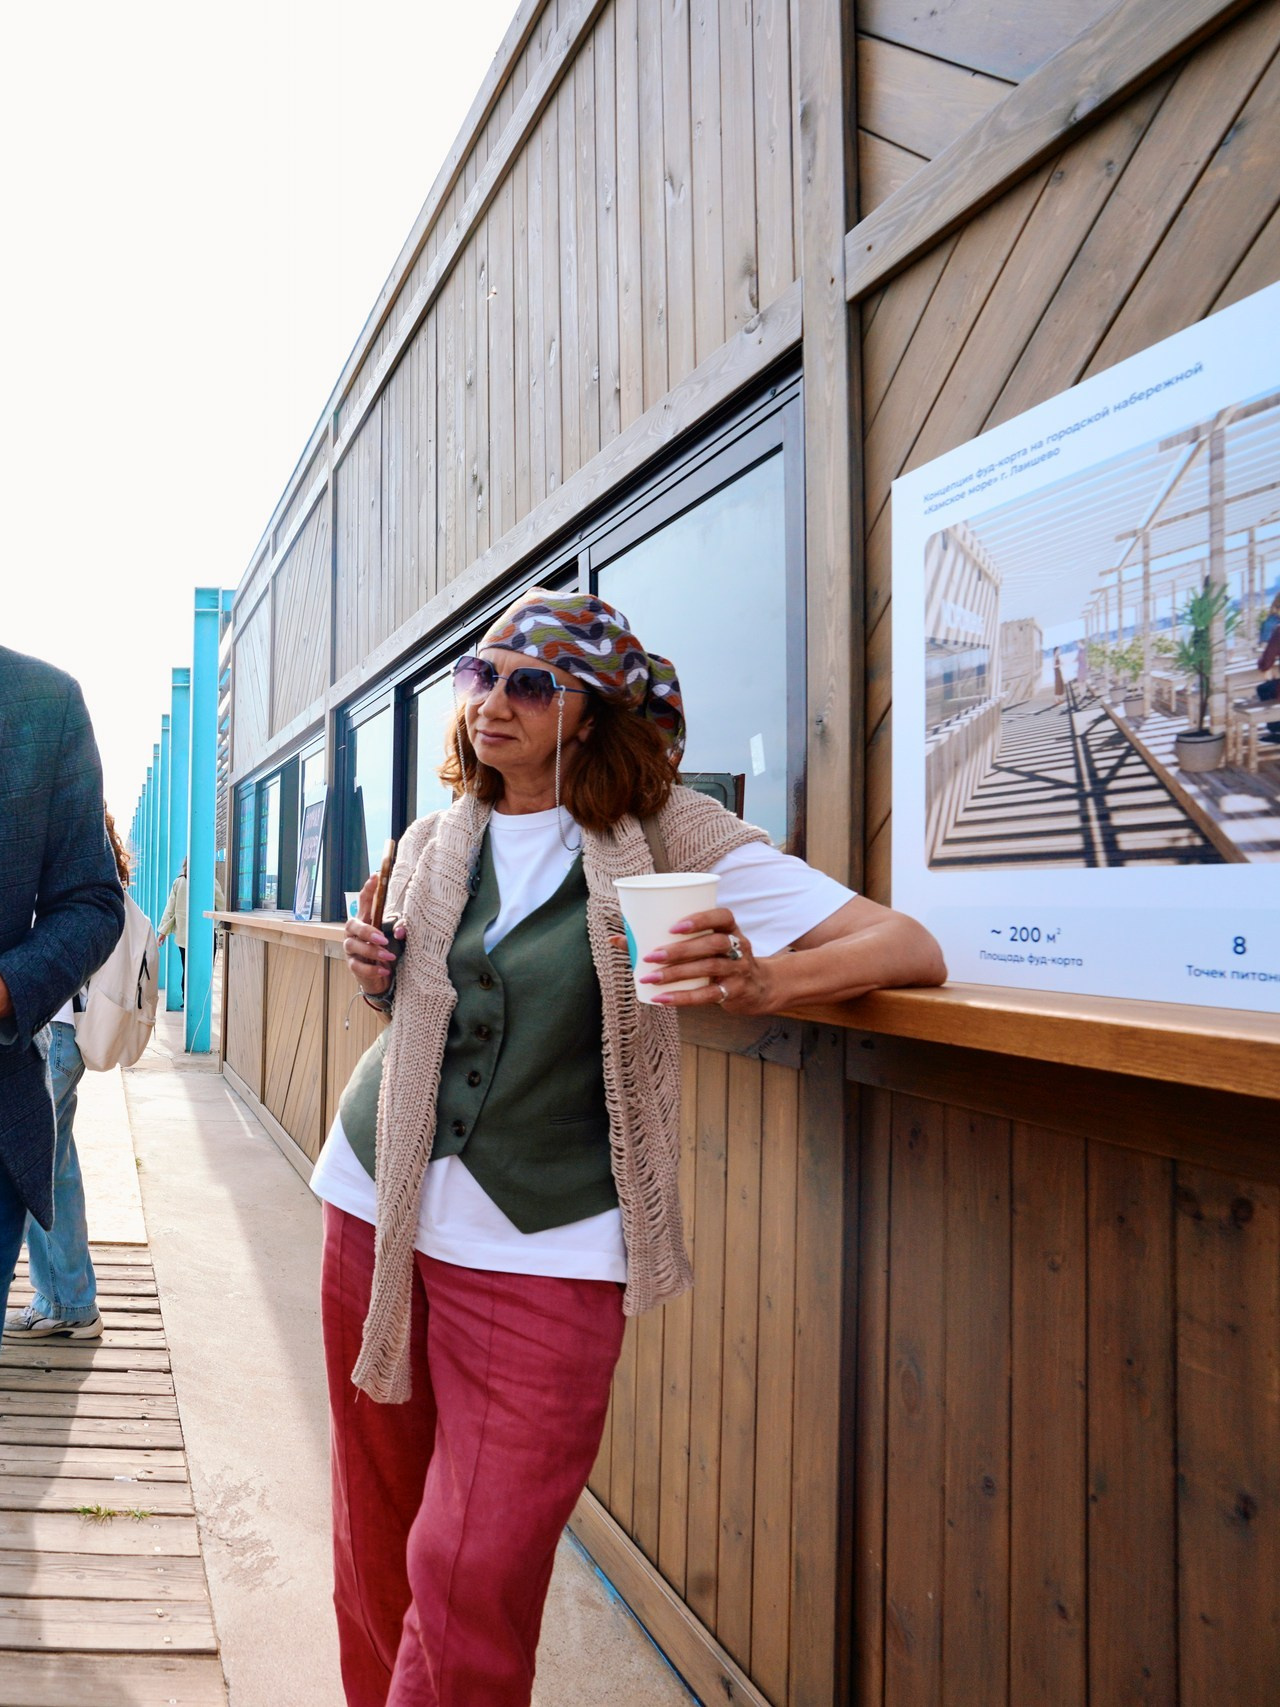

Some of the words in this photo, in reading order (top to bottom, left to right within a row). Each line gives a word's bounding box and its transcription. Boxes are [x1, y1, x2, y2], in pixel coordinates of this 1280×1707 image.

[923, 473, 974, 502] Концепция
[975, 448, 1028, 478] фуд-корта
[1030, 440, 1044, 452] на
[1046, 406, 1111, 444] городской
[1113, 361, 1204, 413] набережной
[1010, 447, 1061, 476] Лаишево
[1009, 926, 1041, 943] 200
[1233, 935, 1247, 955] 8
[979, 949, 1024, 962] Площадь
[1027, 953, 1084, 967] фуд-корта
[1186, 964, 1227, 978] Точек
